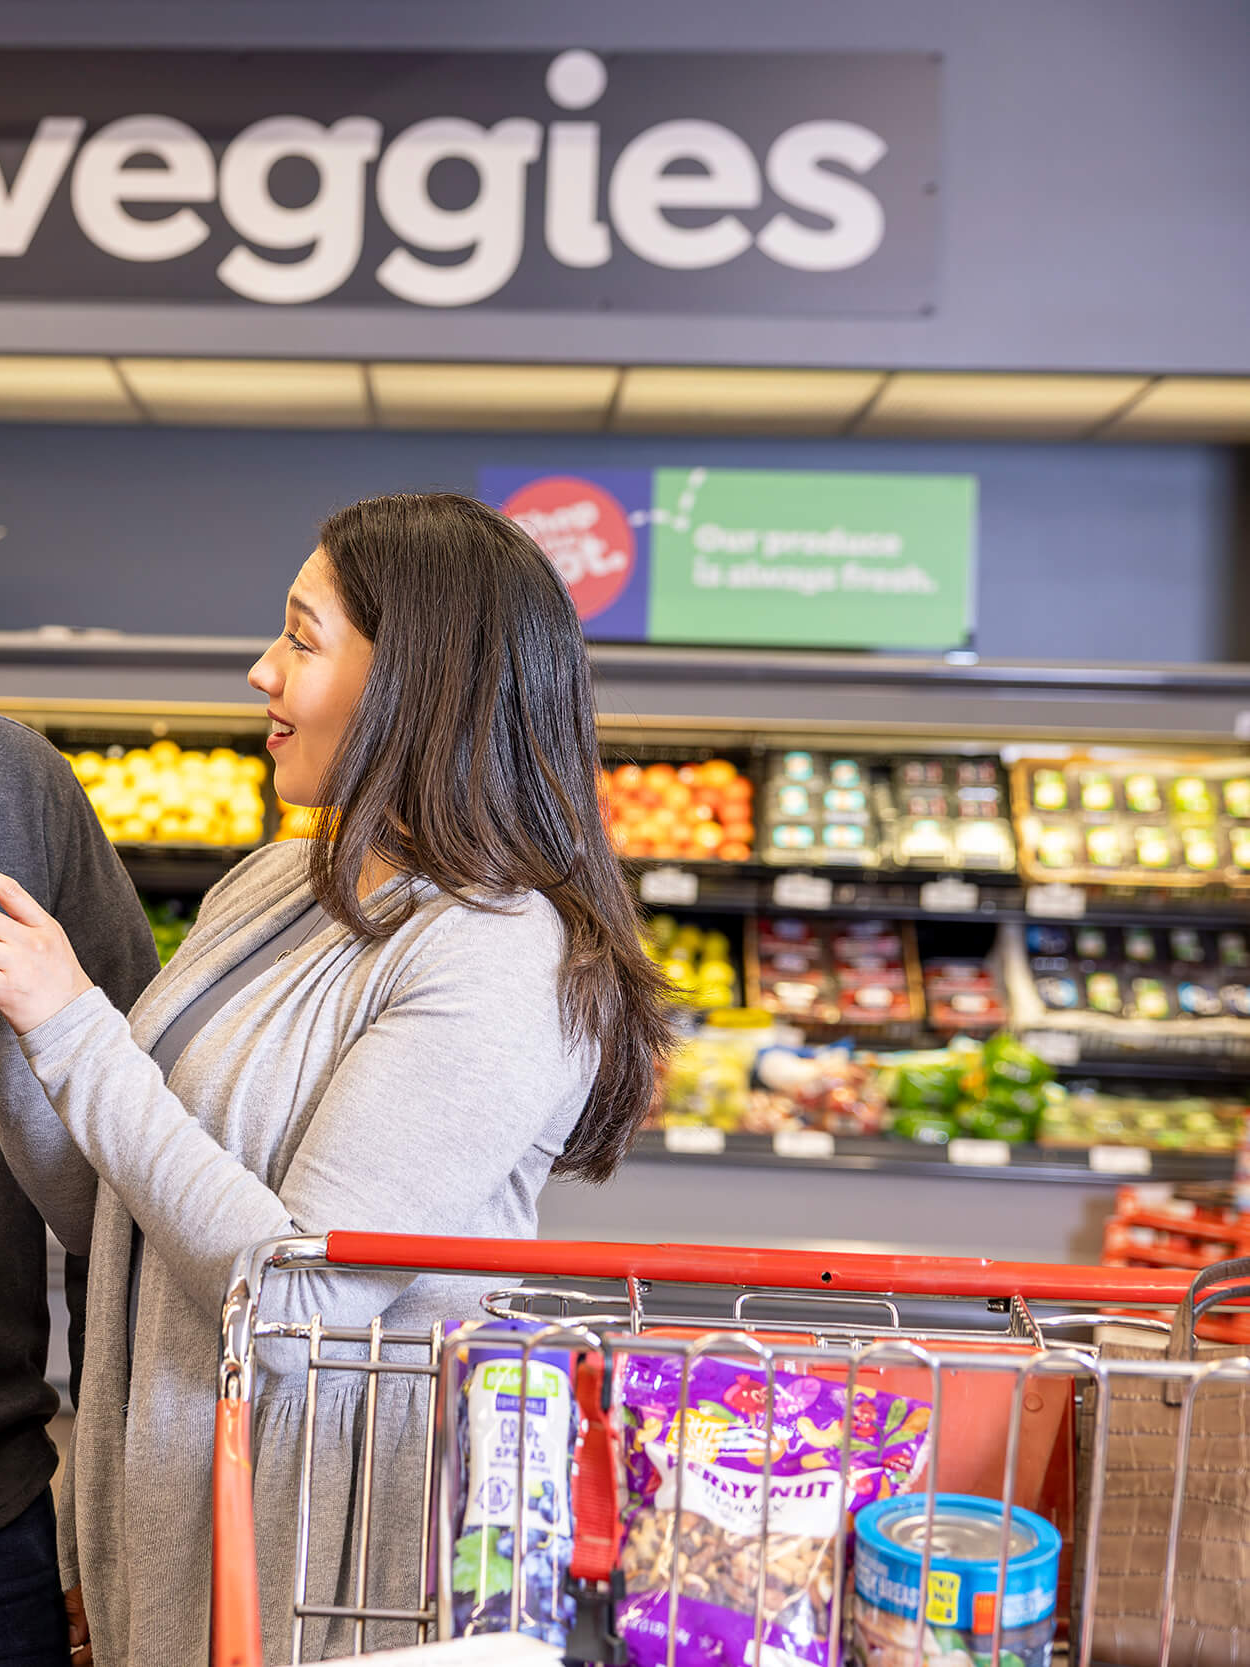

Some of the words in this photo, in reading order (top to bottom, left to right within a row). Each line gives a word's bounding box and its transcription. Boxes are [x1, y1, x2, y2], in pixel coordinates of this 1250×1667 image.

[694, 523, 758, 553] Our
[760, 524, 905, 560] produce
[726, 559, 836, 596] always
